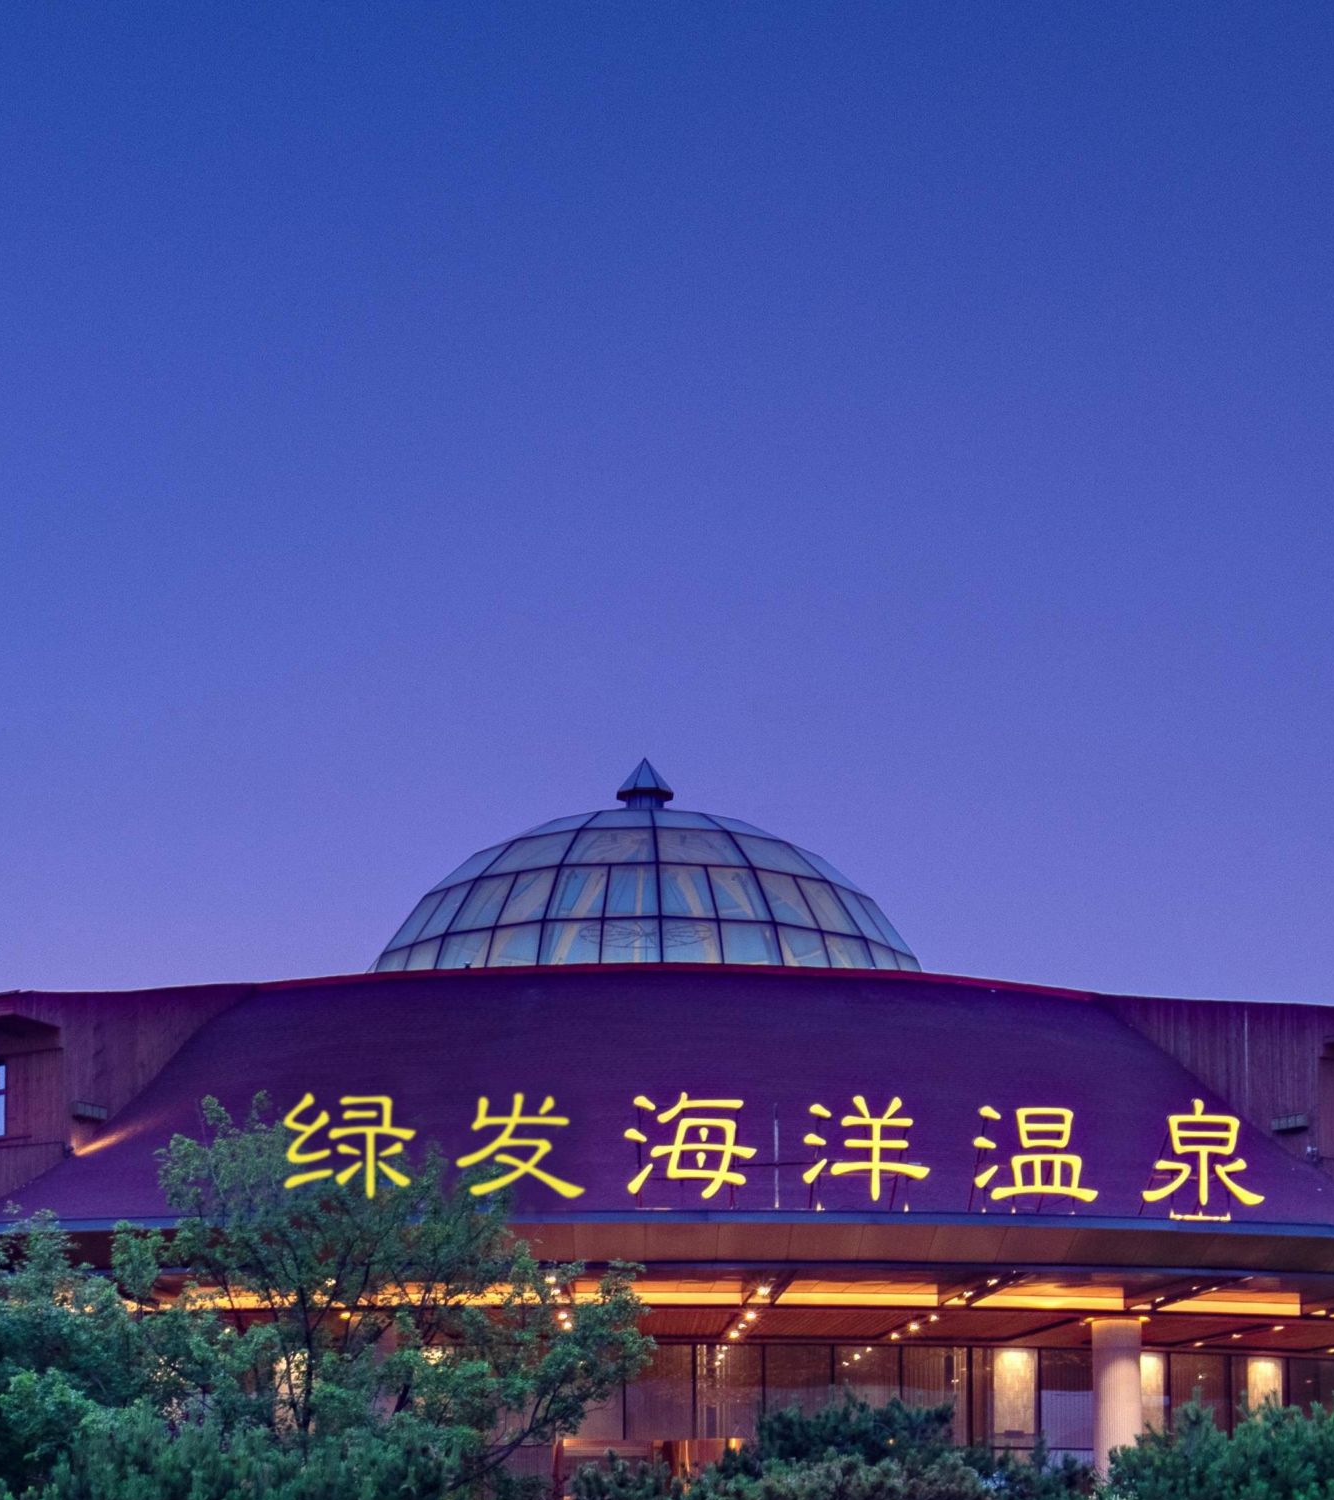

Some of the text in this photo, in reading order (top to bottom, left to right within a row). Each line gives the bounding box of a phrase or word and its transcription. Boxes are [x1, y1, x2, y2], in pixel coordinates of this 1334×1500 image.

[281, 1091, 1266, 1206] 绿发海洋温泉
